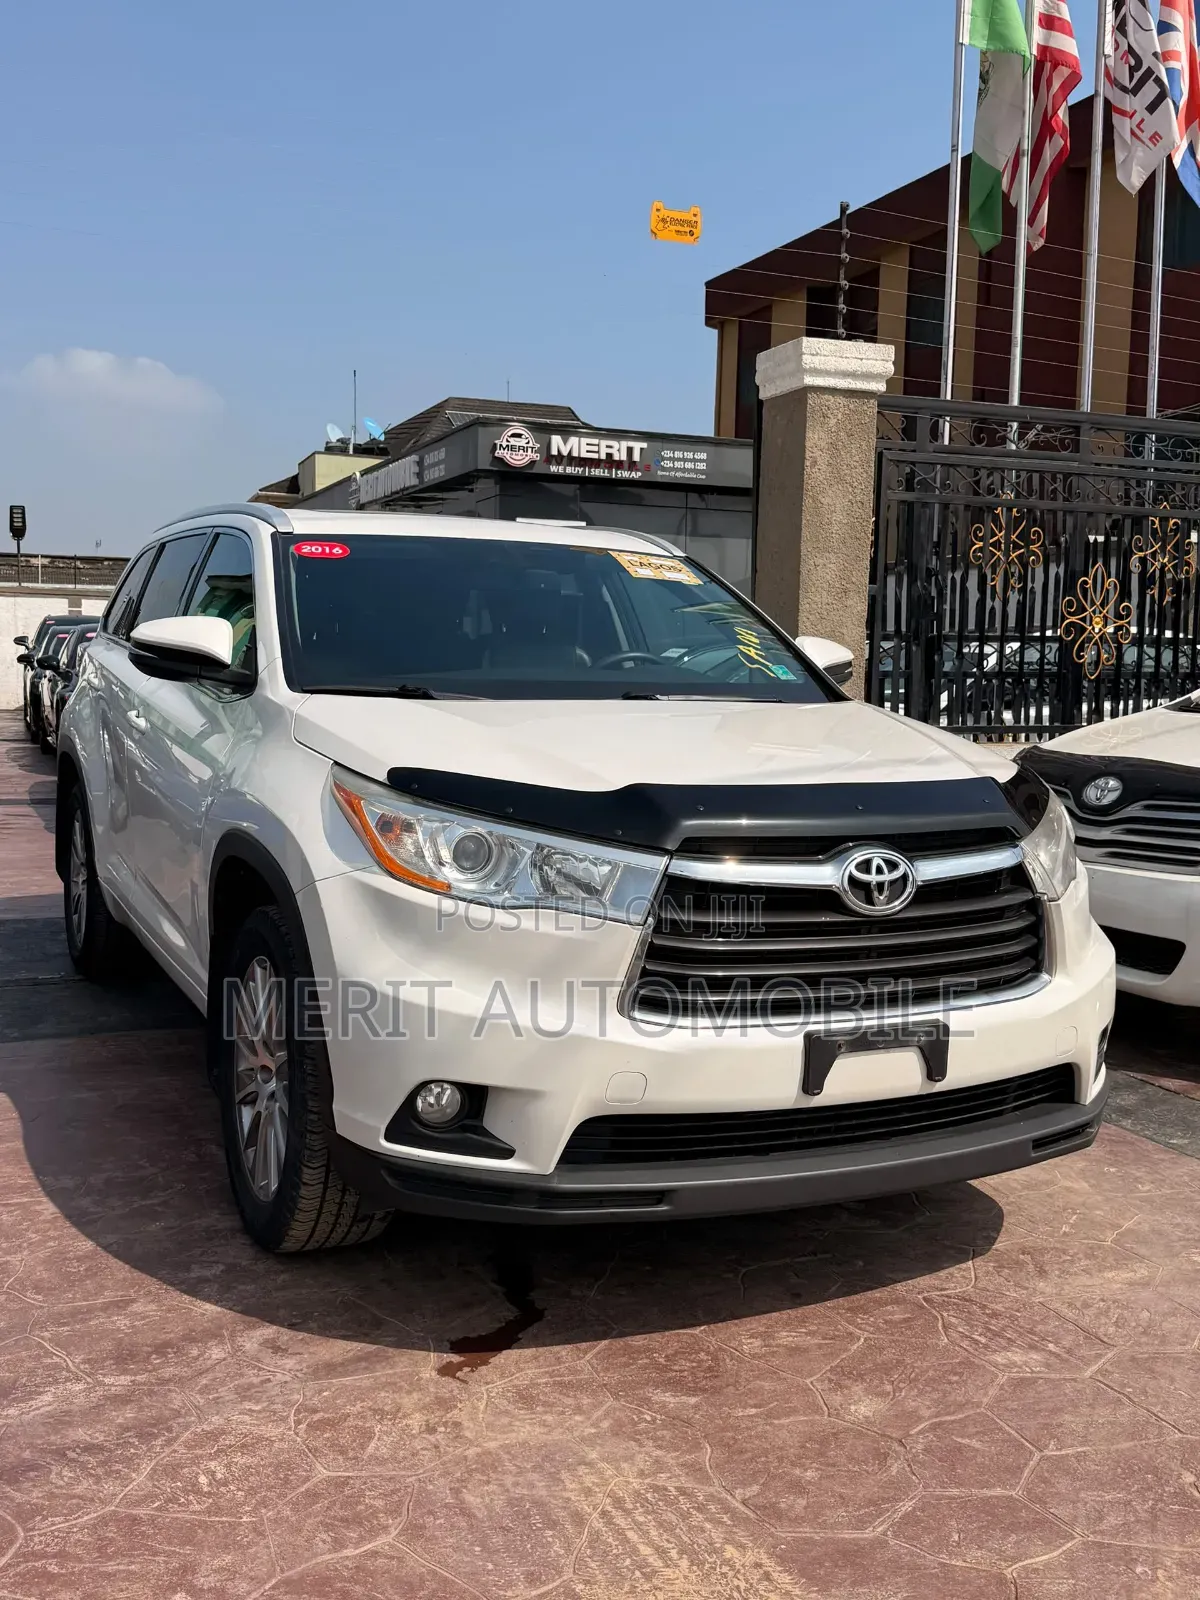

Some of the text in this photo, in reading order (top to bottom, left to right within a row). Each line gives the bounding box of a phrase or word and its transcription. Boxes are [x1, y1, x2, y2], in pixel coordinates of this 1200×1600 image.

[498, 443, 537, 454] MERIT
[550, 434, 648, 462] MERIT
[550, 465, 642, 479] WE BUY SELL SWAP
[301, 545, 343, 554] 2016
[627, 560, 682, 573] LAGOS
